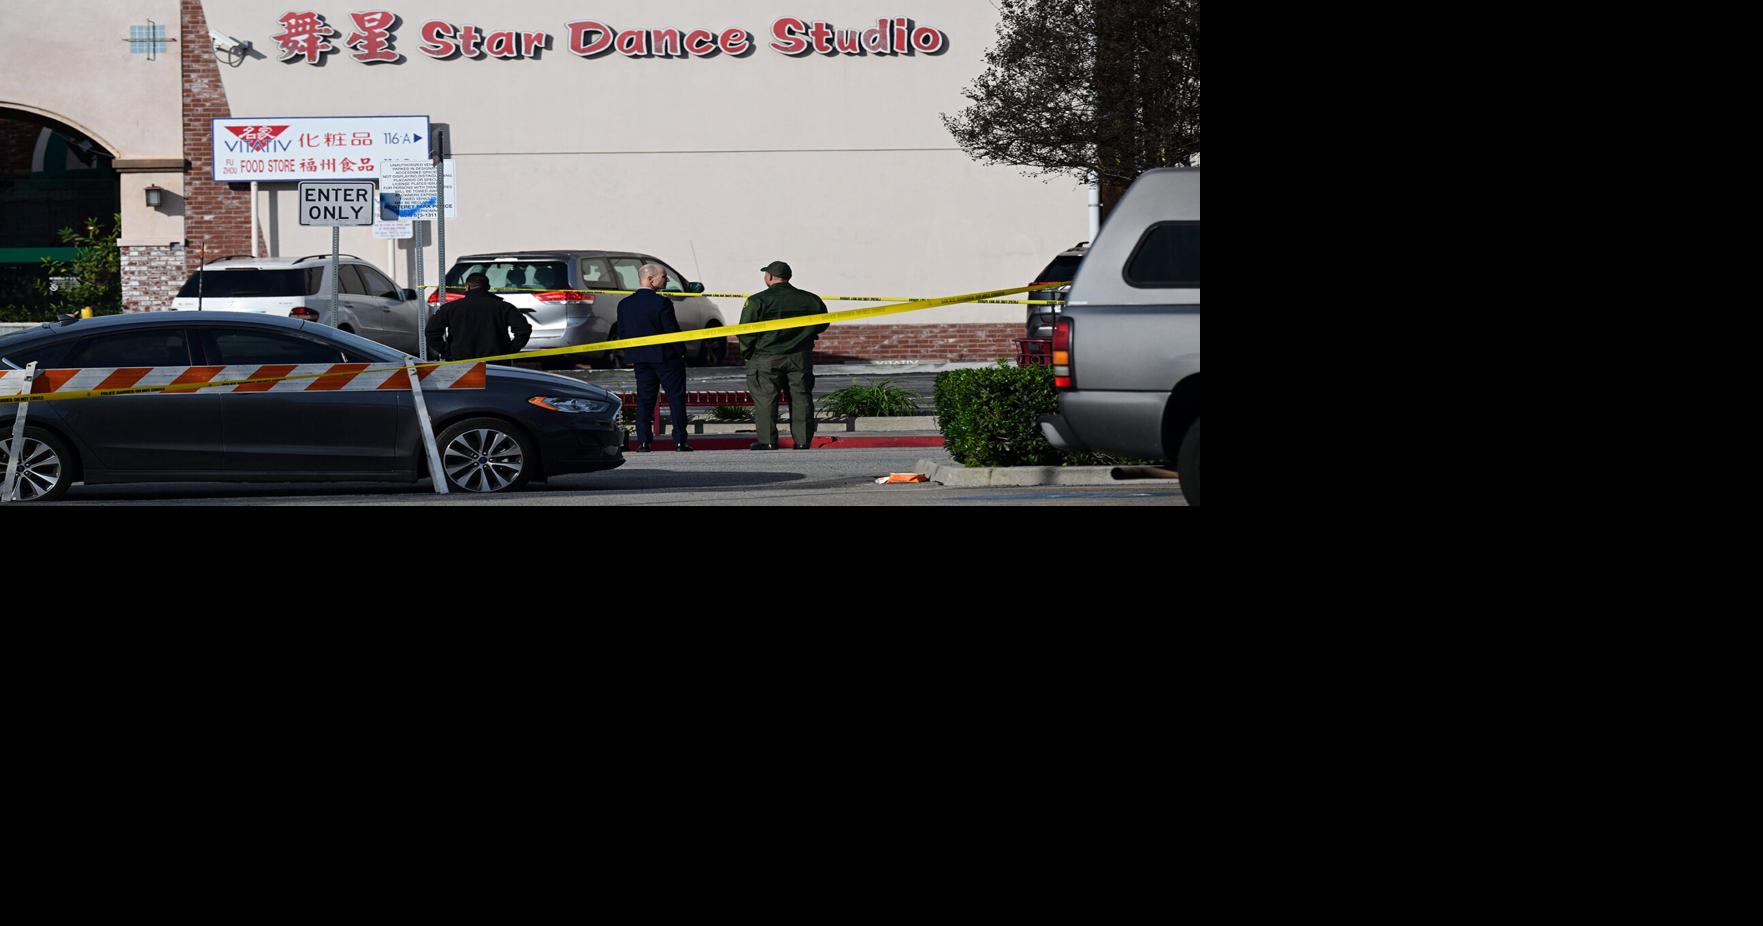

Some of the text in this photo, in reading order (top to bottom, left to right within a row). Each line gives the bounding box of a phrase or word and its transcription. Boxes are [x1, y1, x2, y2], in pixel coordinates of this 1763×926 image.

[272, 10, 399, 64] 舞星
[417, 16, 943, 59] Star Dance Studio
[224, 140, 292, 153] VITATIV
[299, 132, 373, 148] 化粧品
[240, 159, 296, 173] FOOD STORE
[300, 157, 375, 173] 福州食品
[305, 188, 368, 202] ENTER
[309, 206, 364, 219] ONLY
